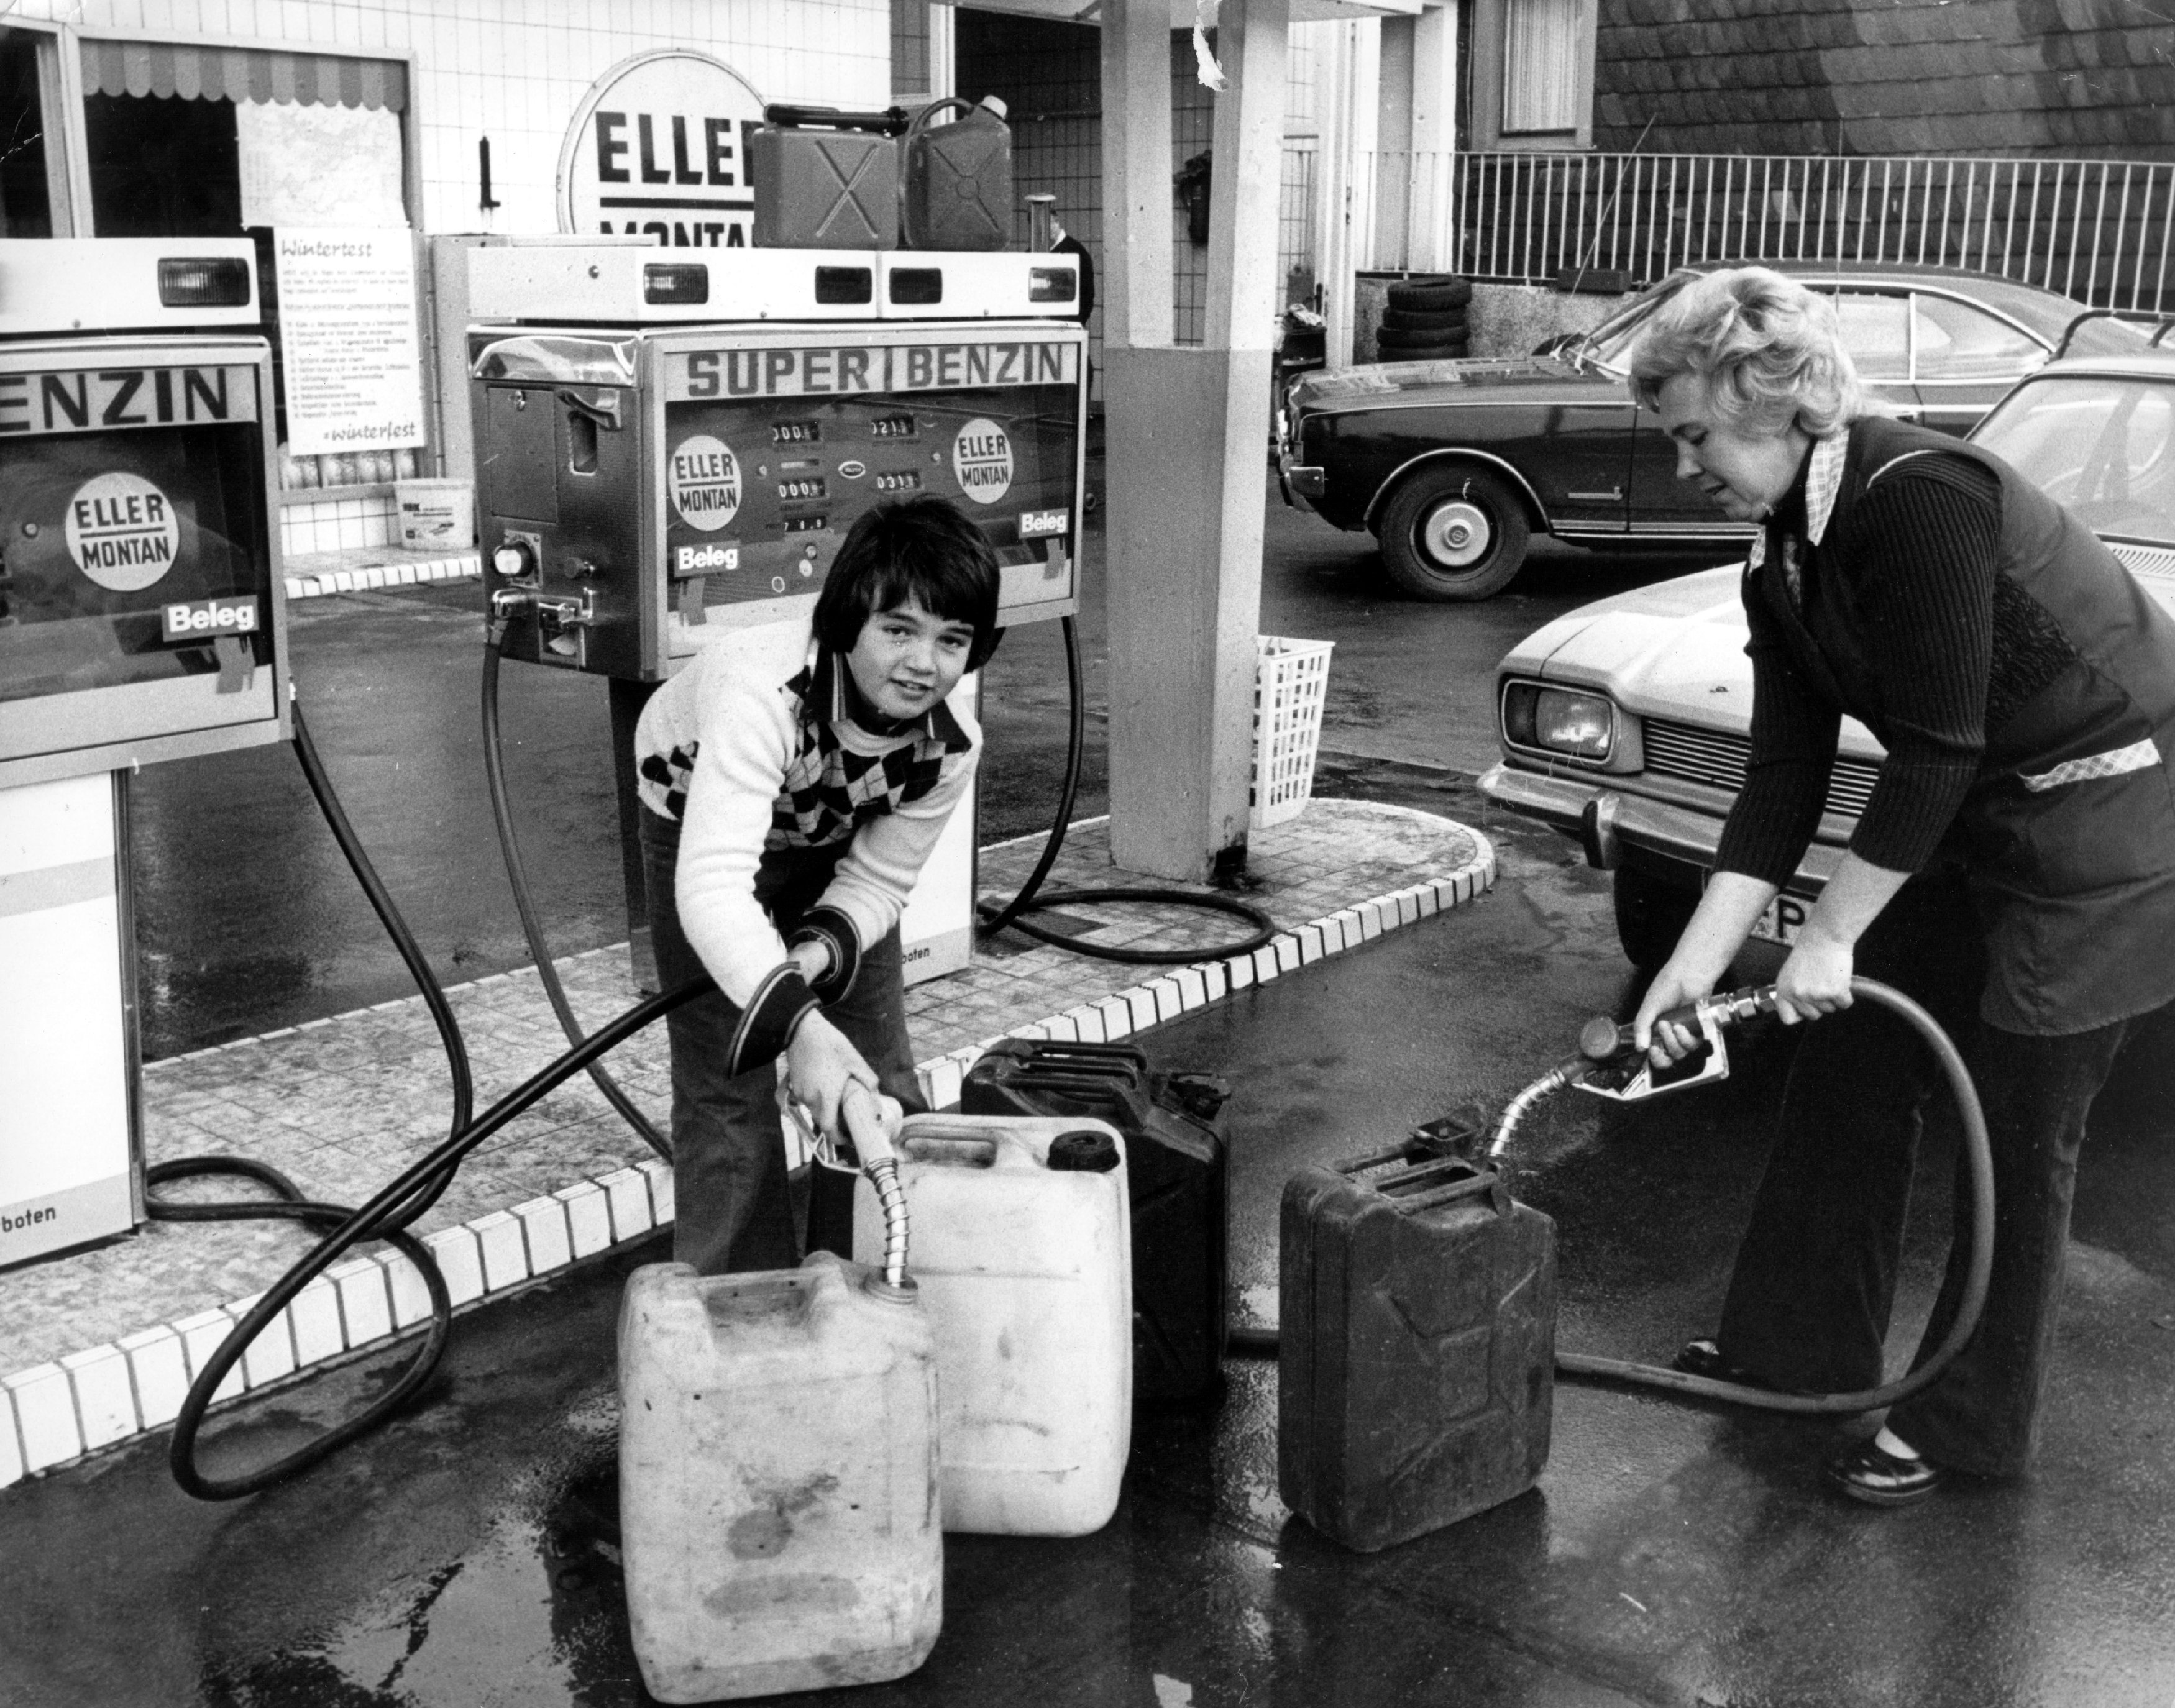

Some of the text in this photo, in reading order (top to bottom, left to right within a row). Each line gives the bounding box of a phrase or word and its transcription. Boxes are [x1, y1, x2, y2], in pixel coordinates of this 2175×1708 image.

[687, 343, 1063, 397] SUPER BENZIN
[958, 434, 1006, 459] ELLER
[675, 452, 733, 480] ELLER
[961, 467, 1009, 486] MONTAN
[75, 492, 165, 529] ELLER
[679, 486, 737, 512] MONTAN
[1020, 509, 1066, 533] Beleg
[81, 536, 170, 570] MONTAN
[678, 544, 738, 570] Beleg
[168, 602, 255, 633] Beleg
[1, 1206, 57, 1233] boten
